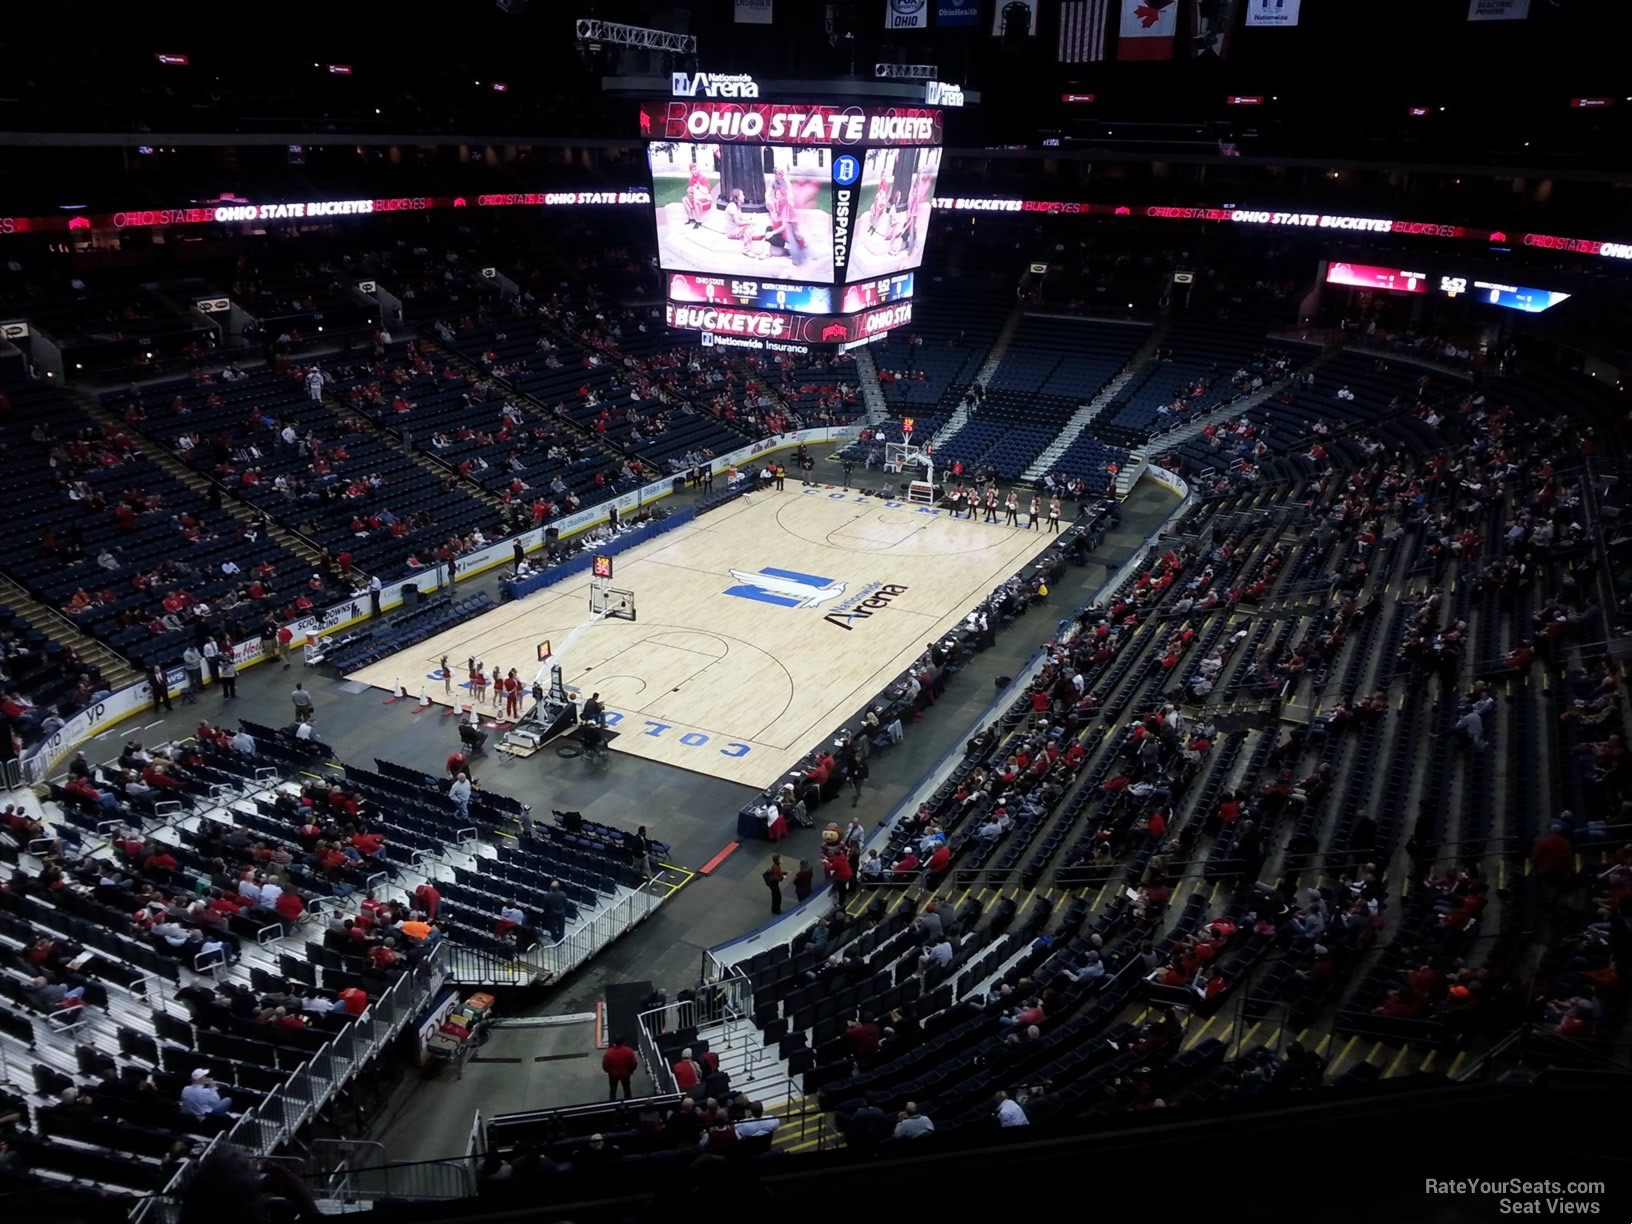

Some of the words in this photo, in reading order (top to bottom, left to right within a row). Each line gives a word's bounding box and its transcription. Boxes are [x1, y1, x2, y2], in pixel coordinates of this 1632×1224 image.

[894, 16, 918, 27] OHIO
[689, 73, 759, 97] Arena
[708, 73, 752, 82] Nationwide
[938, 82, 963, 106] Arena
[688, 111, 763, 136] OHIO
[770, 113, 865, 139] STATE
[869, 116, 933, 139] BUCKEYES
[545, 193, 577, 204] OHIO
[577, 193, 616, 204] STATE
[955, 199, 1023, 212] BUCKEYES
[215, 206, 258, 222] OHIO
[259, 203, 305, 219] STATE
[306, 200, 374, 216] BUCKEYES
[1231, 210, 1271, 223] OHIO
[1271, 212, 1319, 227] STATE
[1319, 215, 1393, 232] BUCKEYES
[835, 190, 850, 267] DISPATCH
[696, 277, 709, 285] OHIO
[709, 278, 725, 286] STATE
[706, 285, 714, 298] 0
[731, 281, 758, 296] 5:52
[1407, 278, 1417, 291] 0
[777, 291, 786, 304] 0
[675, 308, 784, 336] BUCKEYES
[866, 309, 894, 333] OHIO
[714, 336, 763, 349] Nationwide
[766, 341, 808, 354] Insurance
[824, 583, 909, 631] Arena
[831, 580, 882, 614] Nationwide
[325, 603, 352, 620] DOWNS
[86, 703, 105, 726] yp
